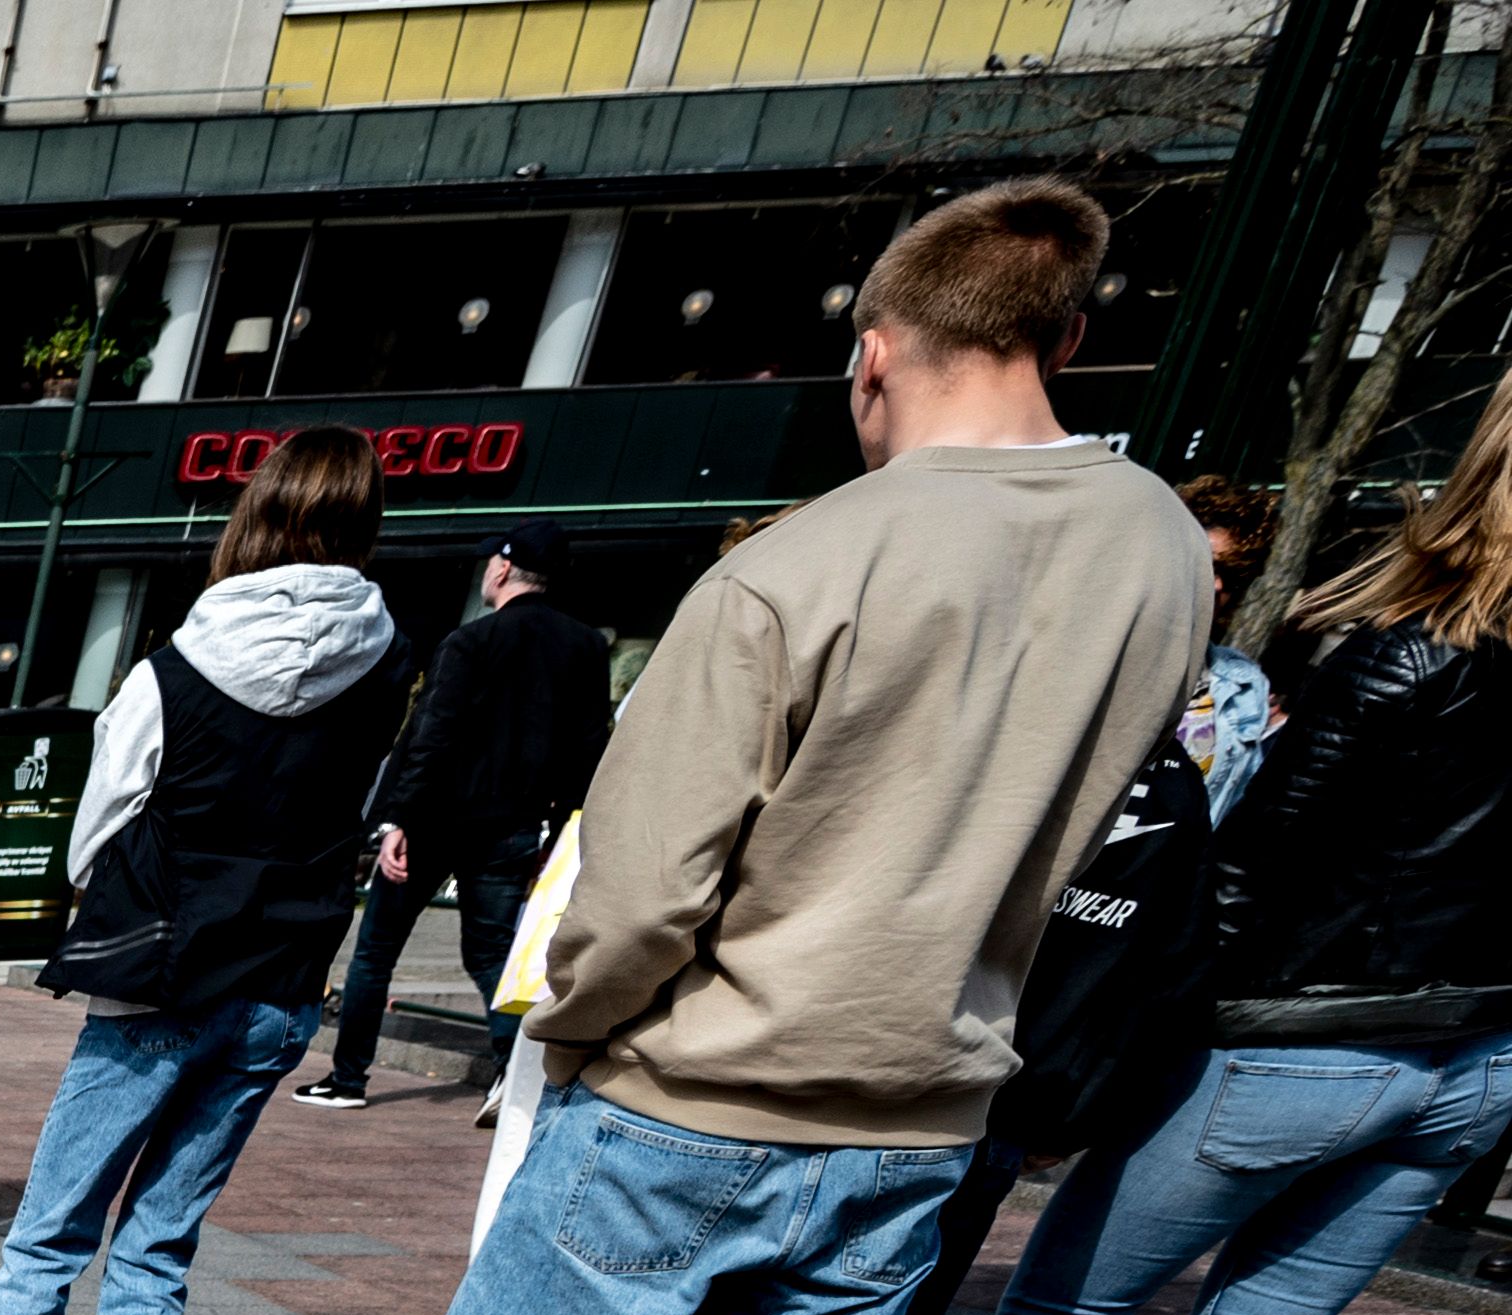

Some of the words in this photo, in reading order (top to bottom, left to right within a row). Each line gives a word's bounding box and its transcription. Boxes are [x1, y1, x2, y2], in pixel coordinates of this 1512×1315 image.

[178, 420, 525, 483] COECO
[7, 804, 40, 814] AVFALL
[1053, 886, 1138, 929] SWEAR
